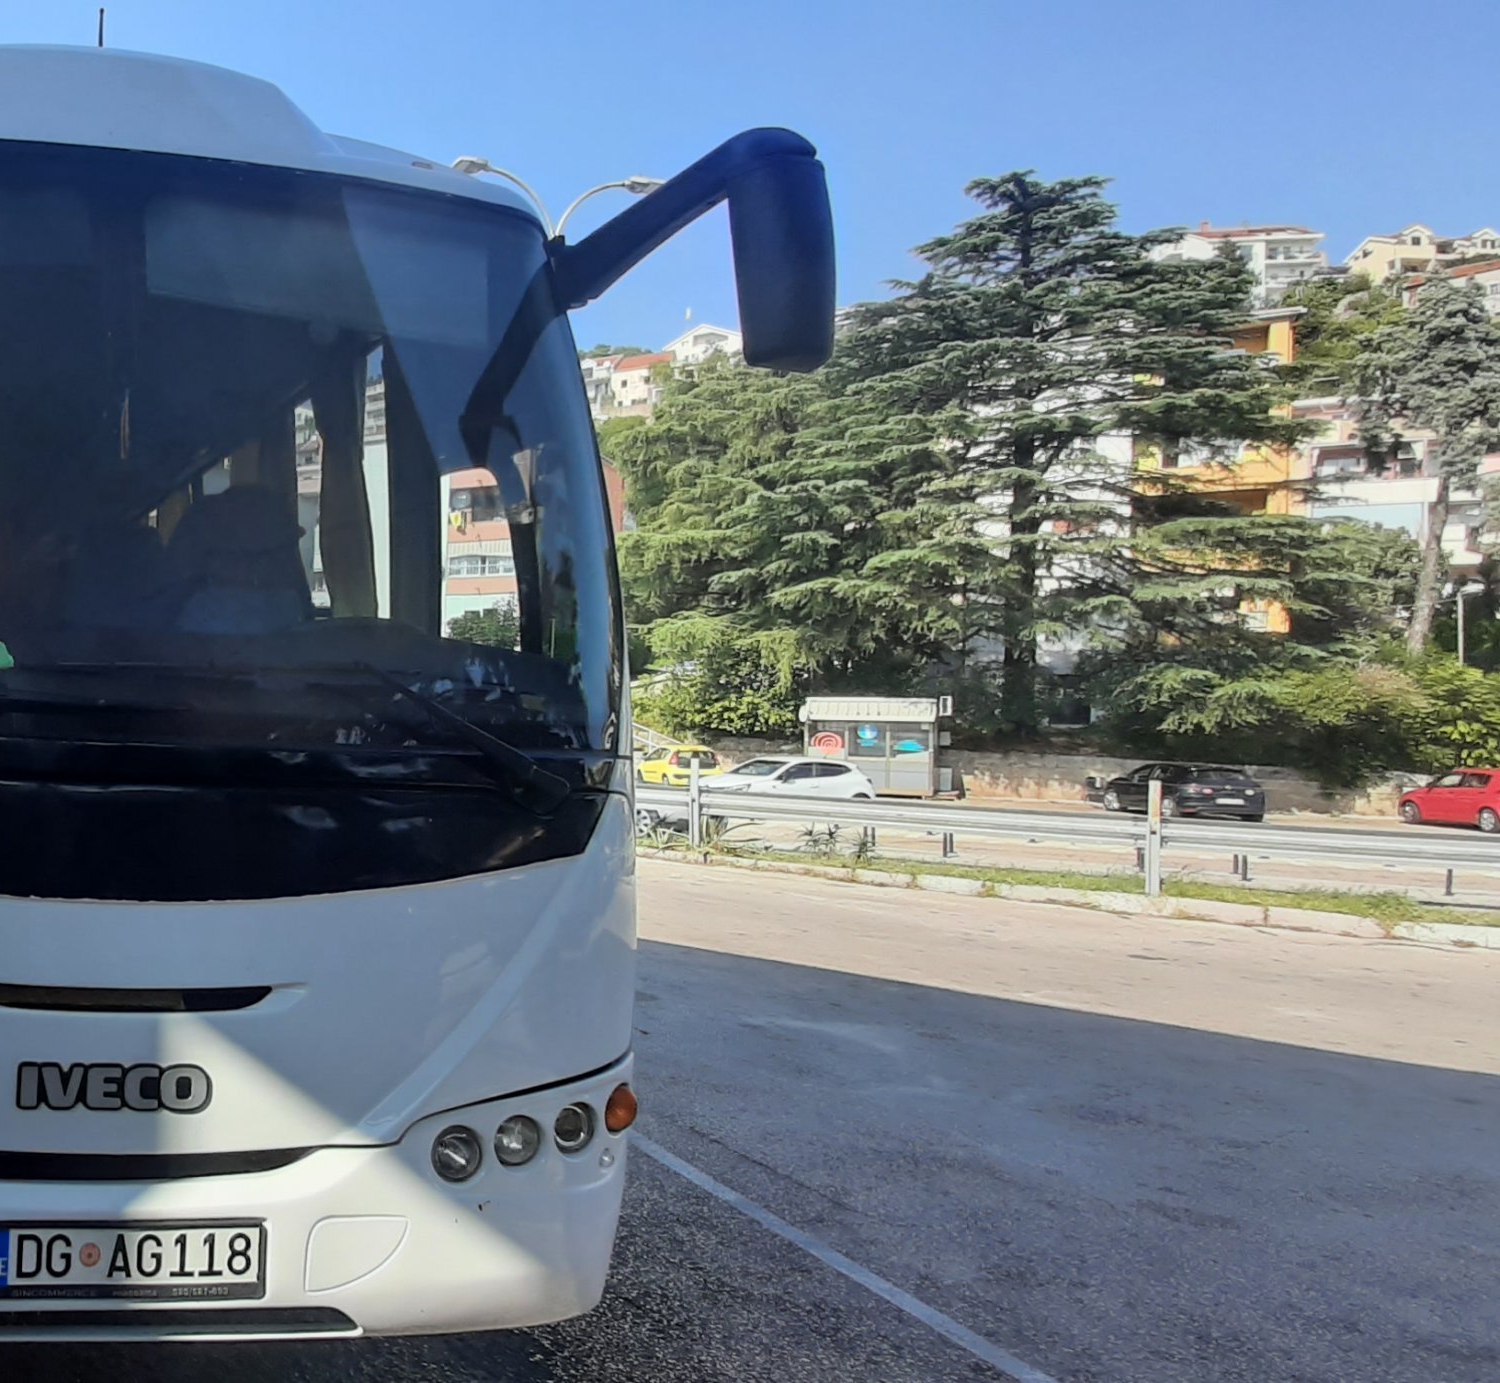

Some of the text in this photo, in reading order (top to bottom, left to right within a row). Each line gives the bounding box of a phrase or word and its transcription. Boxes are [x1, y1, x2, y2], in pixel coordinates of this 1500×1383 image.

[16, 1061, 212, 1114] IVECO
[15, 1232, 252, 1279] DG AG118
